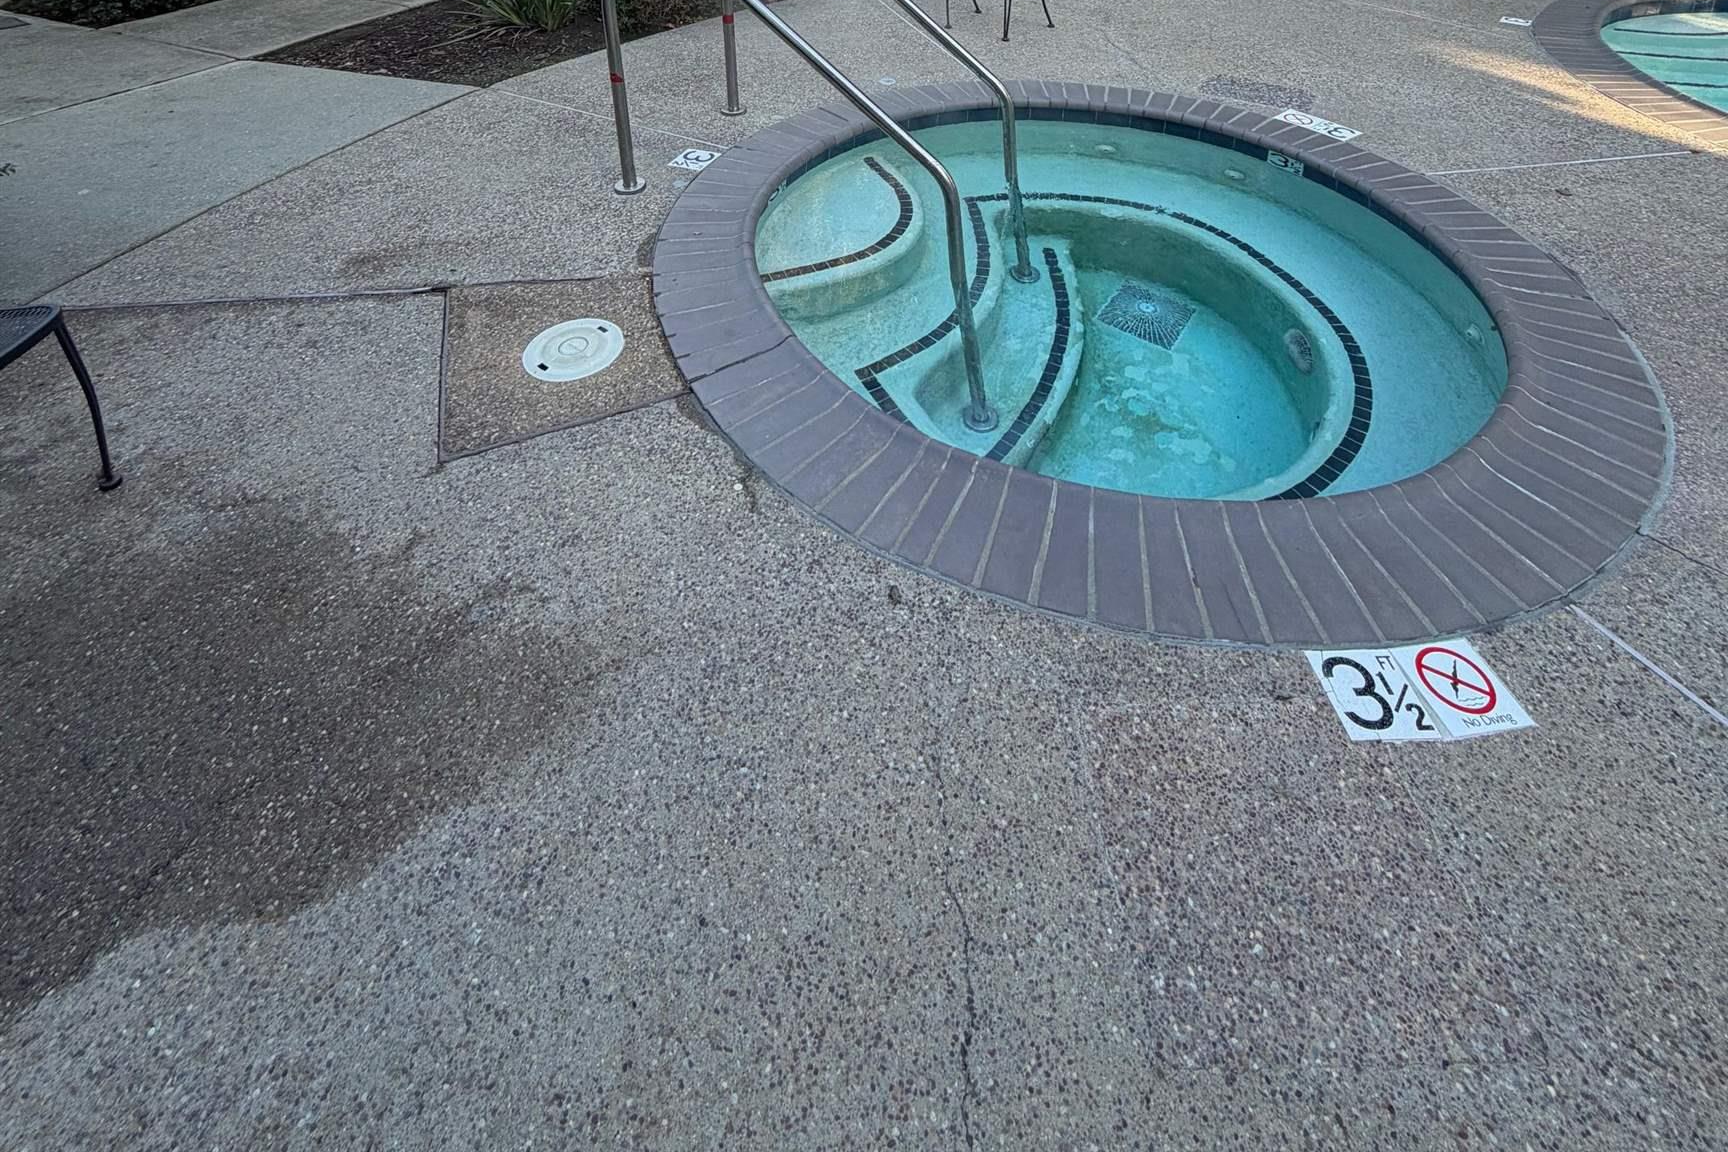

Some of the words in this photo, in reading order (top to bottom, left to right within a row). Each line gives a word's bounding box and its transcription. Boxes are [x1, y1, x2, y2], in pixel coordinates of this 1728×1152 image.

[683, 150, 715, 163] 3
[1375, 655, 1396, 671] FT
[1461, 717, 1481, 729] No
[1480, 713, 1518, 726] Diving
